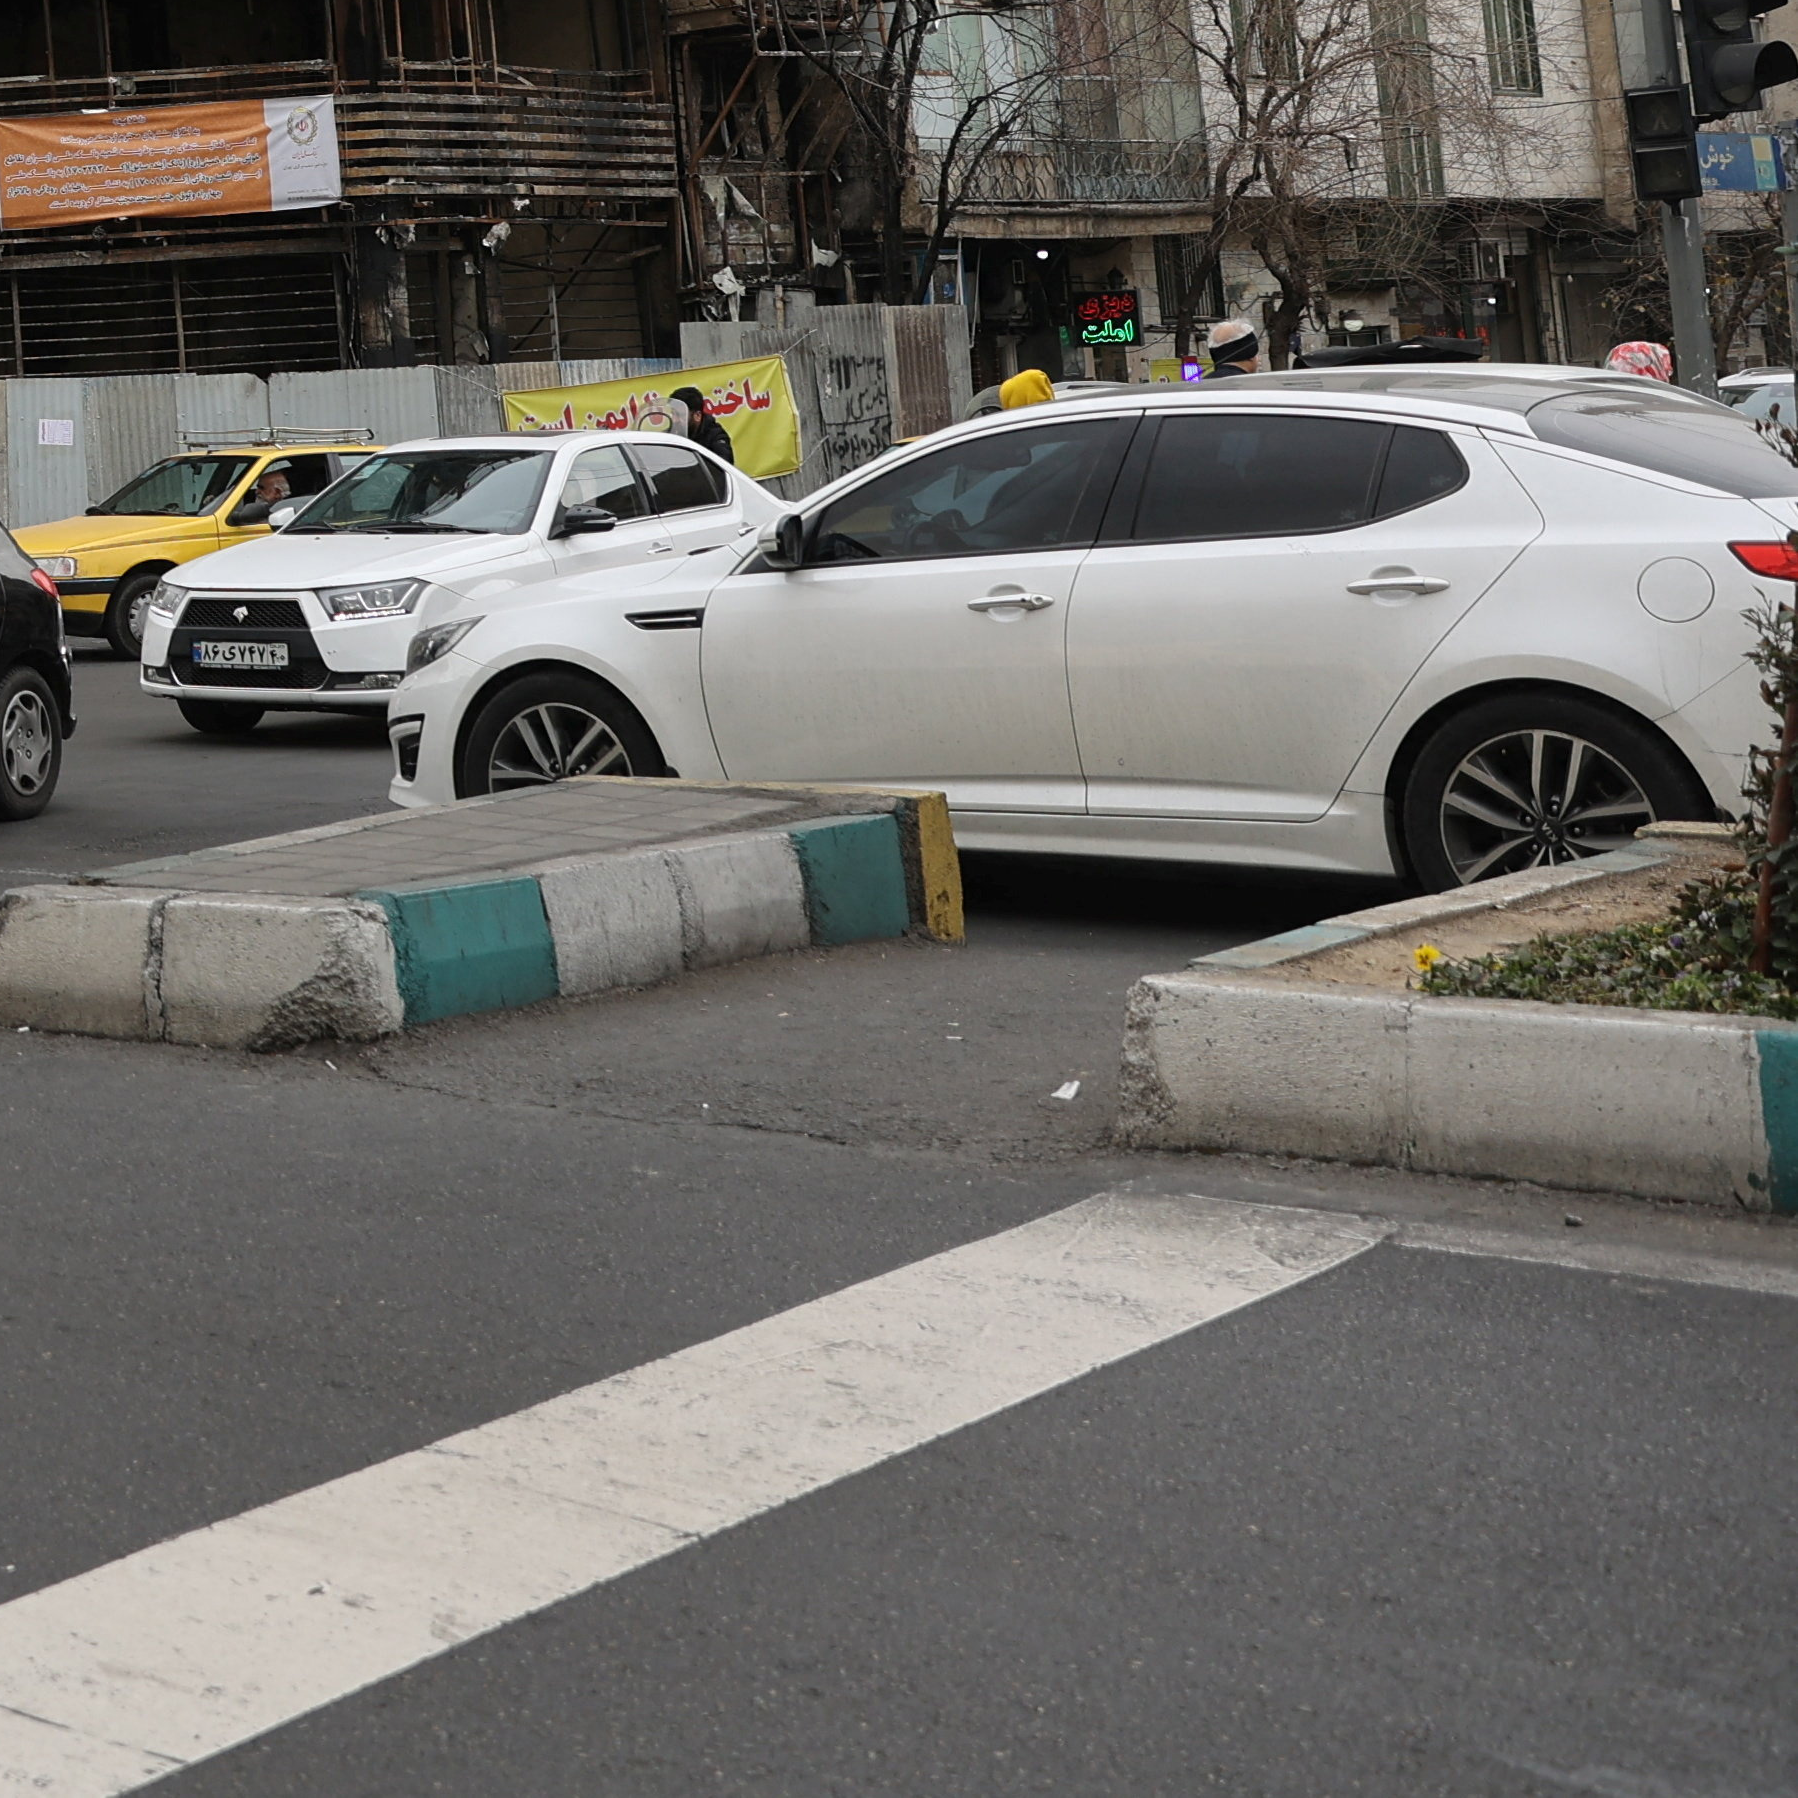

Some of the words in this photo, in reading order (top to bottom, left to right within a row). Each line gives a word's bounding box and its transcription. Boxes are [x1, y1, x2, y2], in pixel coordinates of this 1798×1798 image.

[1700, 144, 1734, 170] خوش
[1078, 294, 1135, 320] دیزی
[1082, 319, 1134, 343] املت
